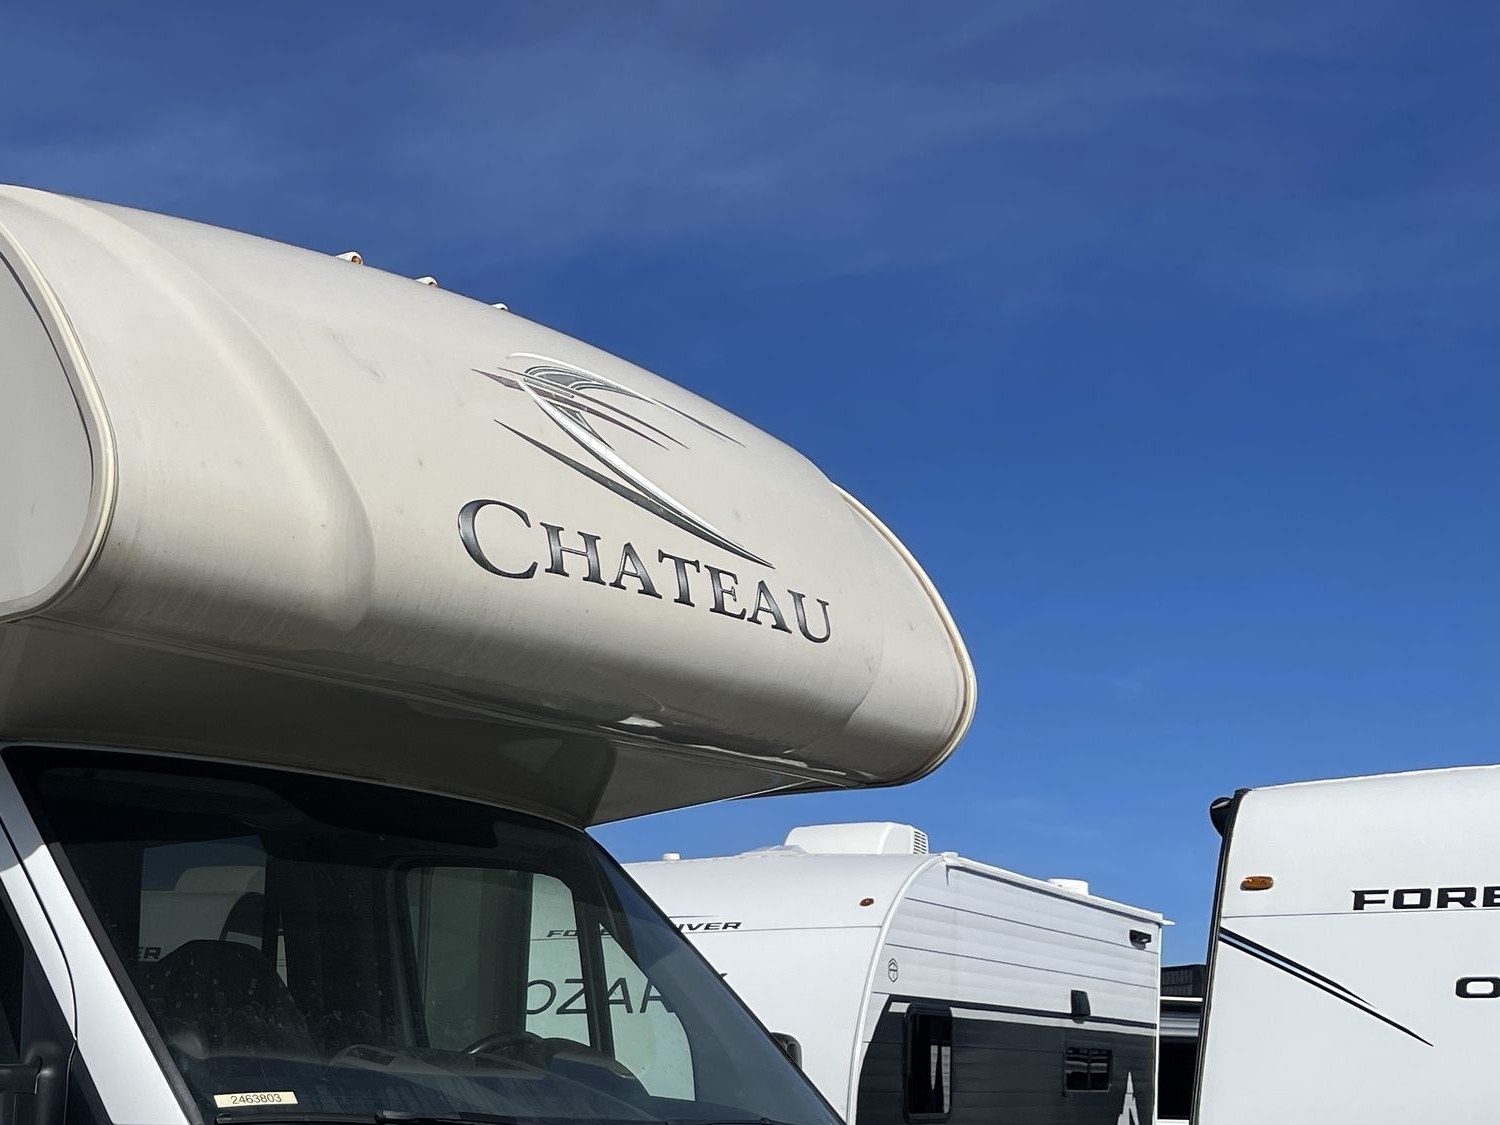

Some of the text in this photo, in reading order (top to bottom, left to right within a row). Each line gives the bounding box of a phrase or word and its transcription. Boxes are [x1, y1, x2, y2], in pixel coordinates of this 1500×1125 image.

[457, 498, 831, 644] CHATEAU
[677, 922, 742, 931] IVER
[230, 1093, 282, 1105] 2463803
